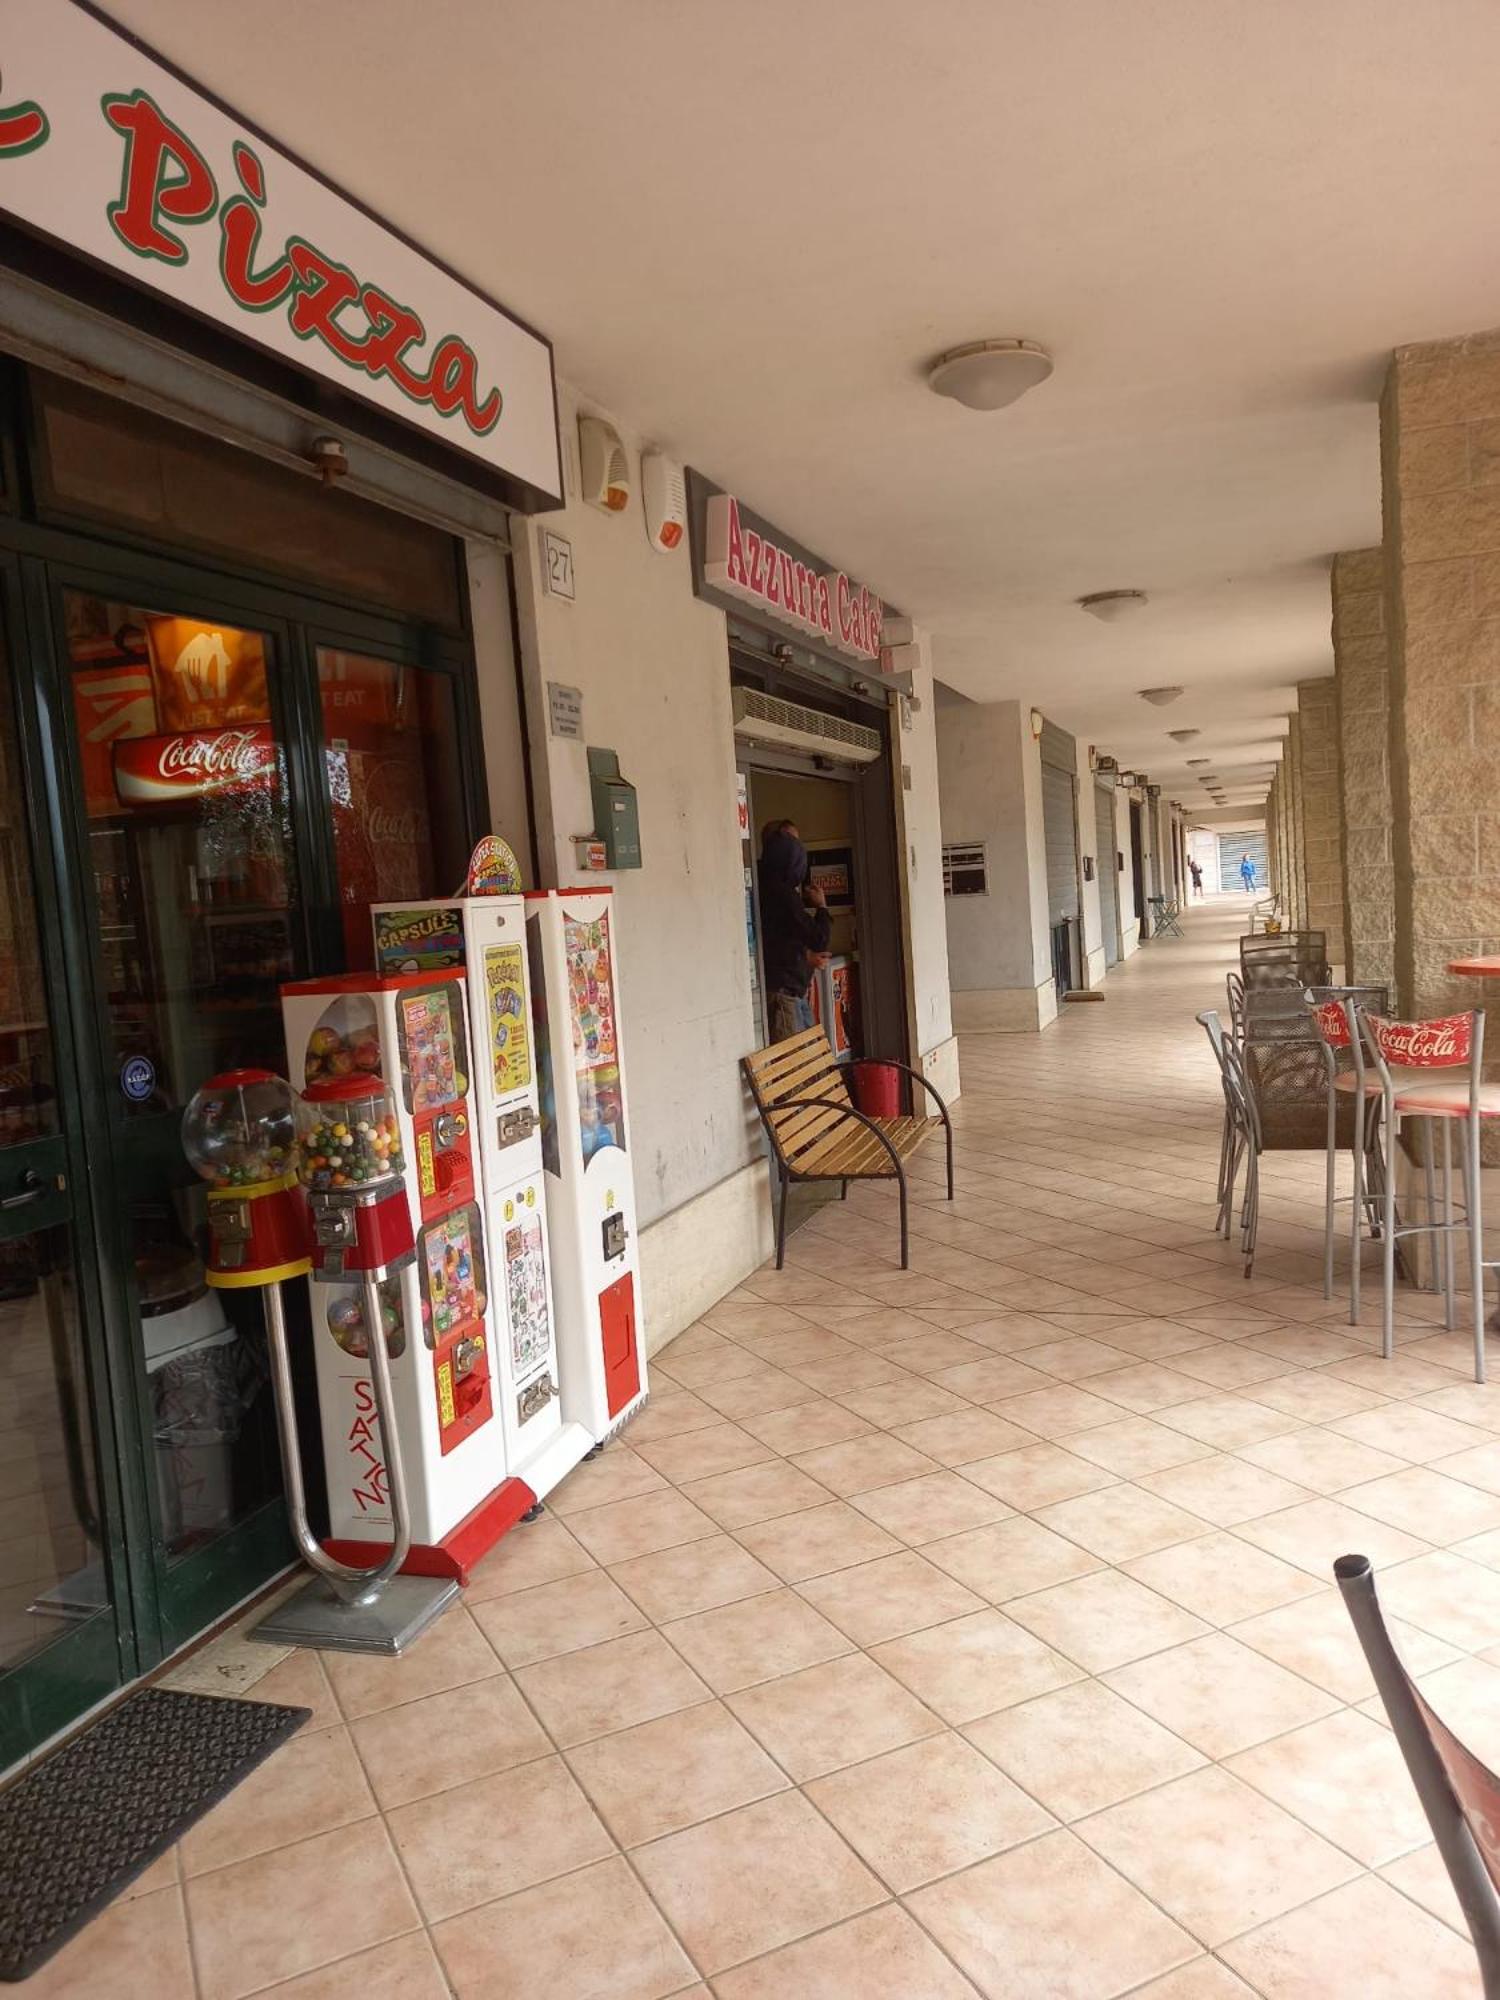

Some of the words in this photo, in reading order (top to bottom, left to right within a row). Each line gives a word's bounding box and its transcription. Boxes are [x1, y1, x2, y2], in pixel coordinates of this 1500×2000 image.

[101, 89, 502, 436] Pizza
[547, 546, 569, 584] 27
[727, 494, 833, 635] Azzurra
[334, 689, 367, 707] EAT
[377, 911, 452, 950] CAPSULE
[348, 1380, 390, 1512] SATION
